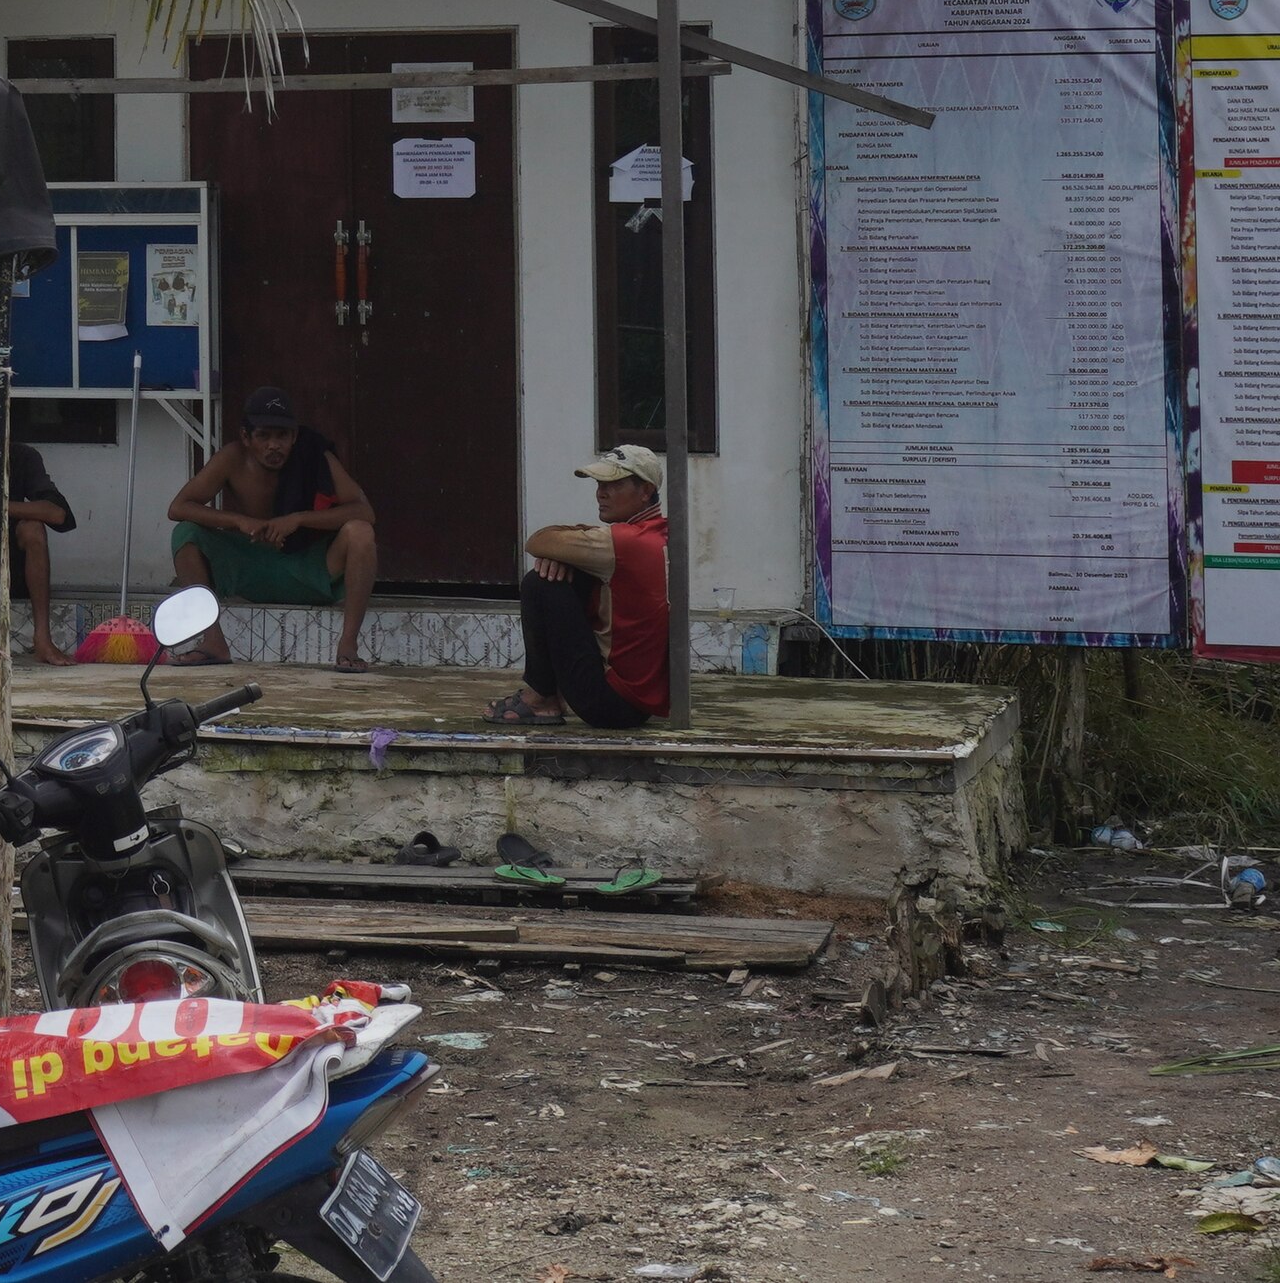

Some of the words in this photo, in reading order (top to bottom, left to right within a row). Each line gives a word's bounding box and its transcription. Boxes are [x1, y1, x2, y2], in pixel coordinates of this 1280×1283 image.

[943, 0, 988, 7] KECAMATAN
[951, 9, 993, 17] KABUPATEN
[995, 8, 1023, 16] BANJAR
[944, 19, 969, 27] TAHUN
[1013, 18, 1031, 26] 2024
[329, 1202, 367, 1245] DA
